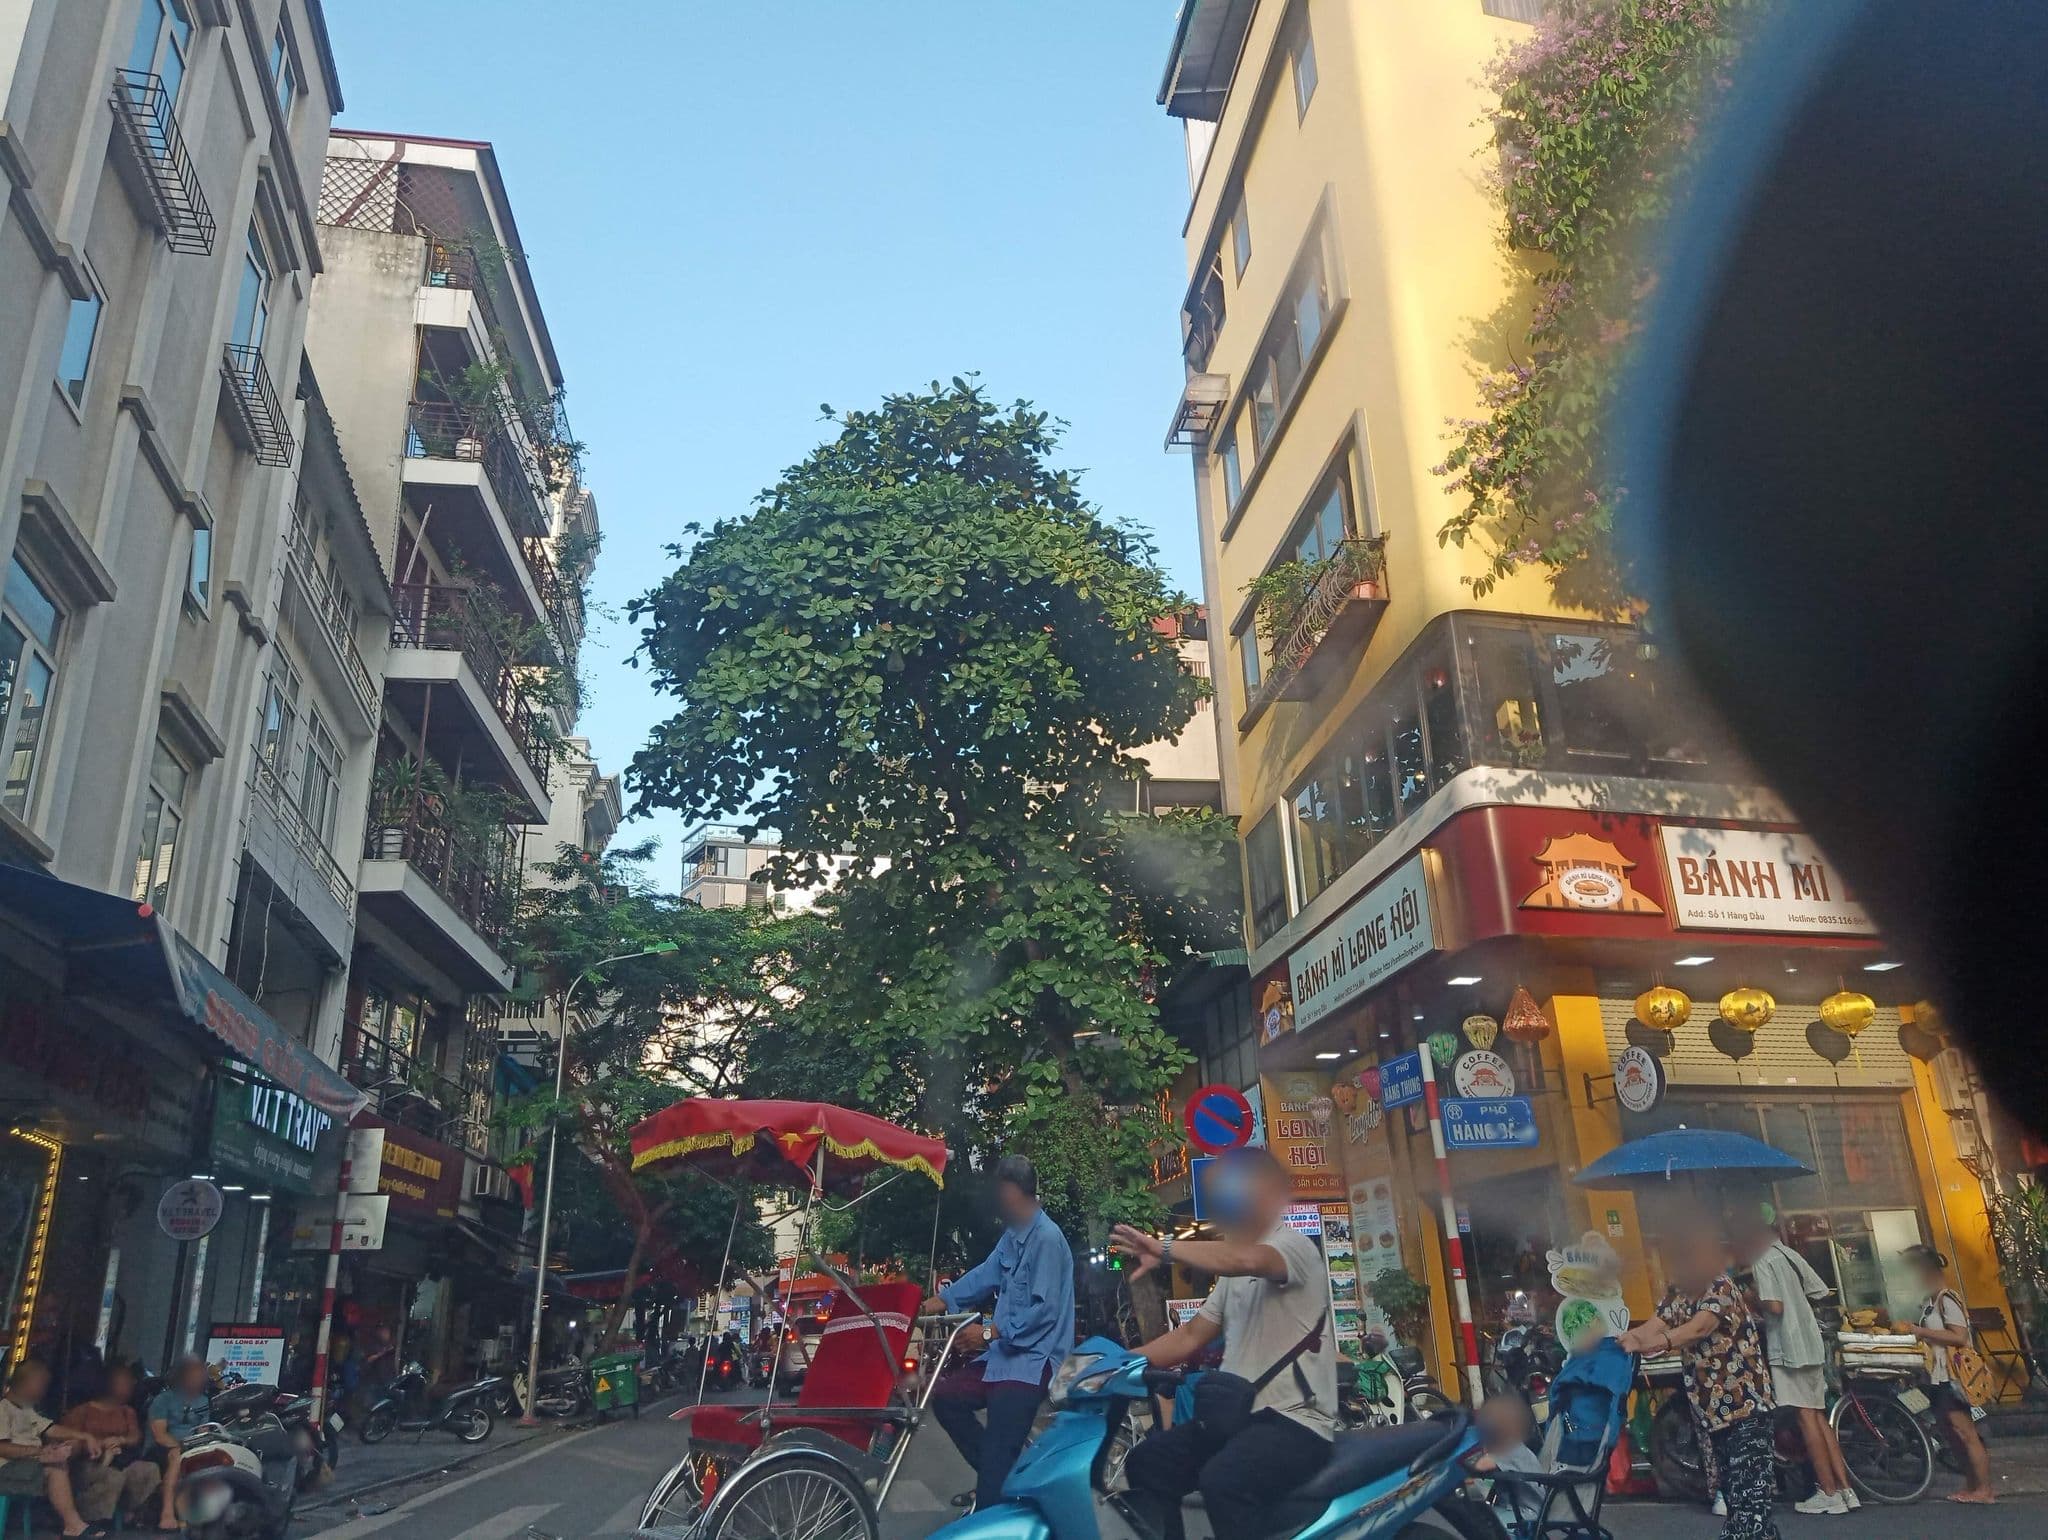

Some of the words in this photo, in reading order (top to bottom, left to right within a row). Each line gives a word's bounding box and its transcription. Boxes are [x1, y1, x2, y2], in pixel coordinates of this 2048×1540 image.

[1677, 849, 1781, 899] BÁNH
[1789, 855, 1831, 902] MÌ
[1687, 908, 1706, 918] Add:
[1296, 955, 1330, 1006] BÁNH
[1331, 936, 1347, 983] MÌ
[1348, 913, 1388, 971] LONG
[1390, 886, 1421, 941] HỘI
[1396, 1062, 1410, 1075] PHỐ
[1463, 1052, 1506, 1070] COFFEE
[1617, 1050, 1647, 1072] COFFEE
[1480, 1102, 1508, 1115] PHỐ
[1276, 1118, 1329, 1139] LONG
[1452, 1119, 1496, 1141] HÀNG
[1288, 1142, 1328, 1170] HỘI
[1293, 1204, 1319, 1213] EXCHANGE
[1321, 1205, 1337, 1214] DAILY
[1338, 1205, 1349, 1214] TOU
